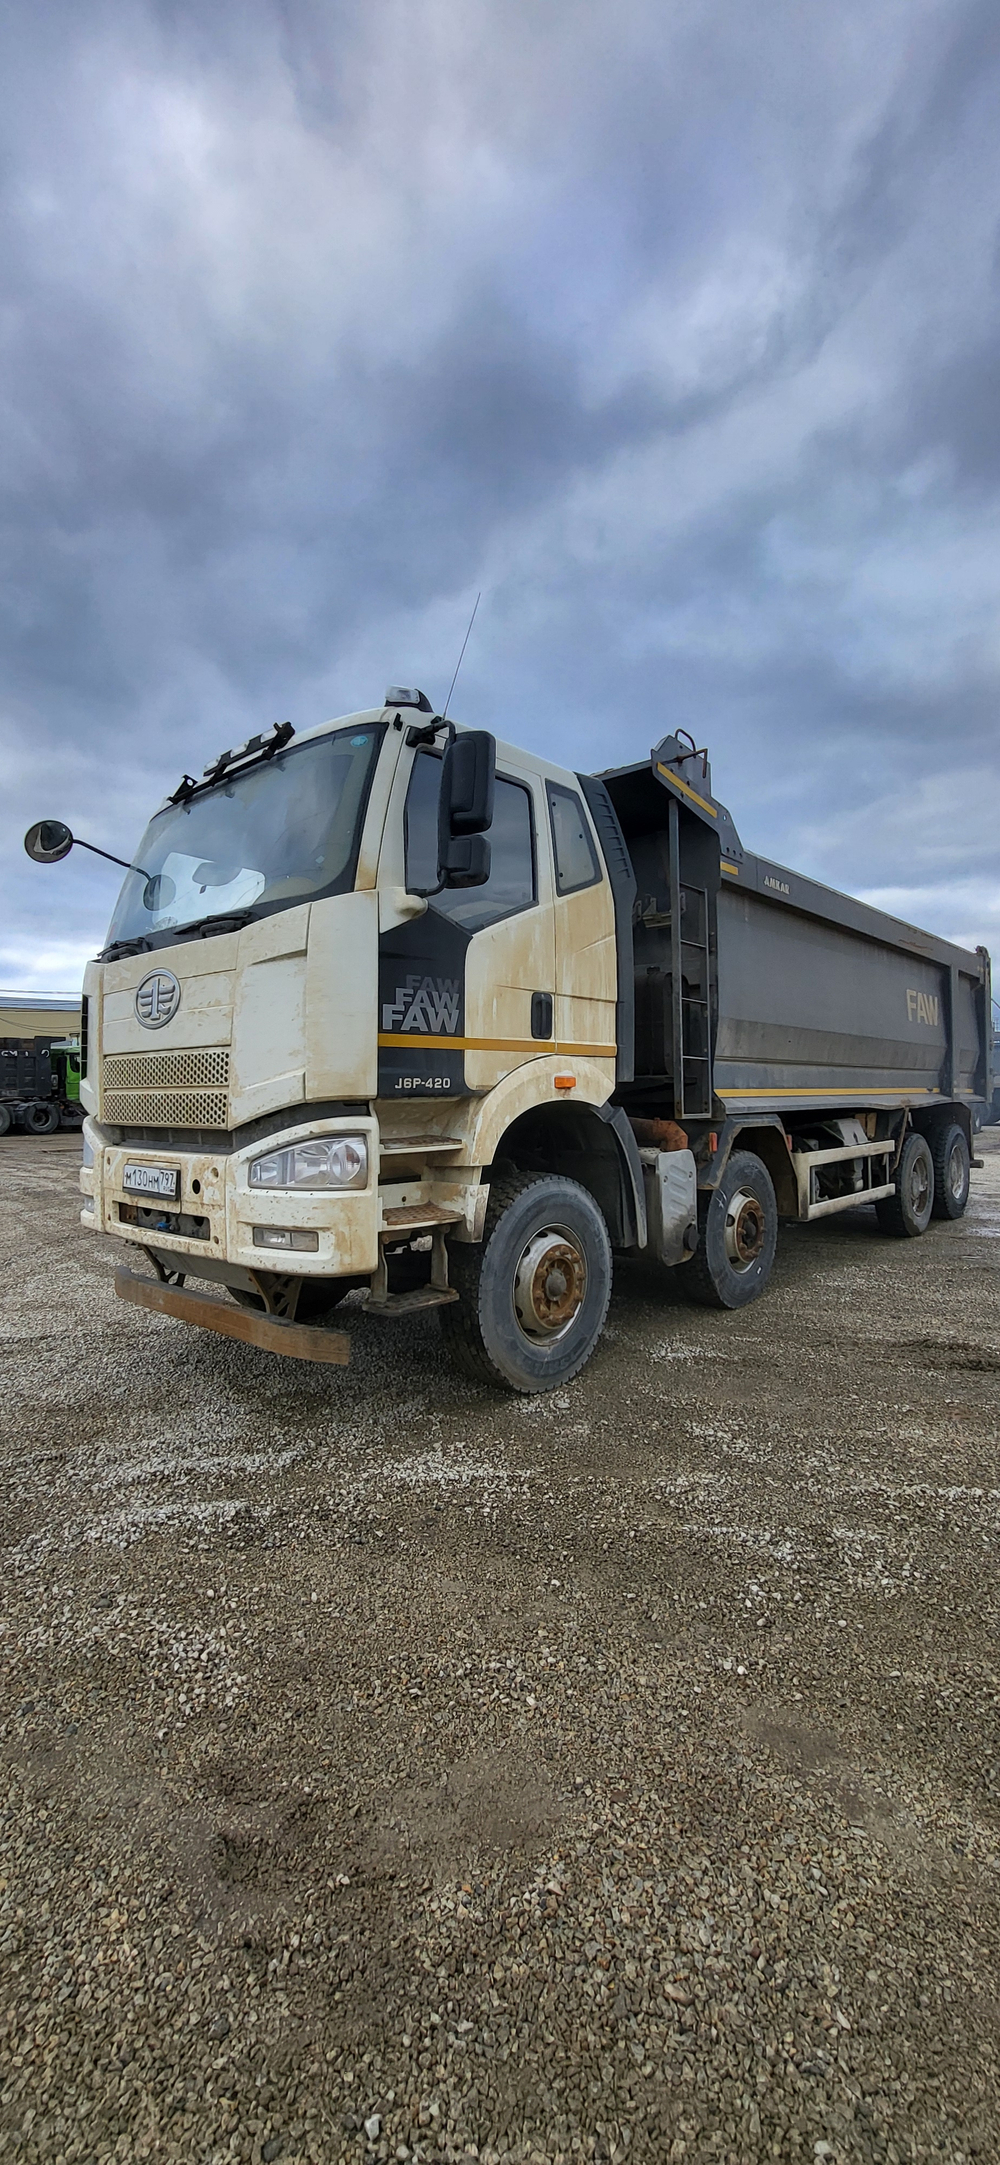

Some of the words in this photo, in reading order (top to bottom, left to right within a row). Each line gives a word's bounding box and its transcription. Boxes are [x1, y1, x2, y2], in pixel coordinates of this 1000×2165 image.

[395, 987, 460, 1011] FAW
[906, 988, 938, 1026] FAW
[382, 1003, 460, 1033] FAW
[394, 1077, 451, 1089] J6P-420
